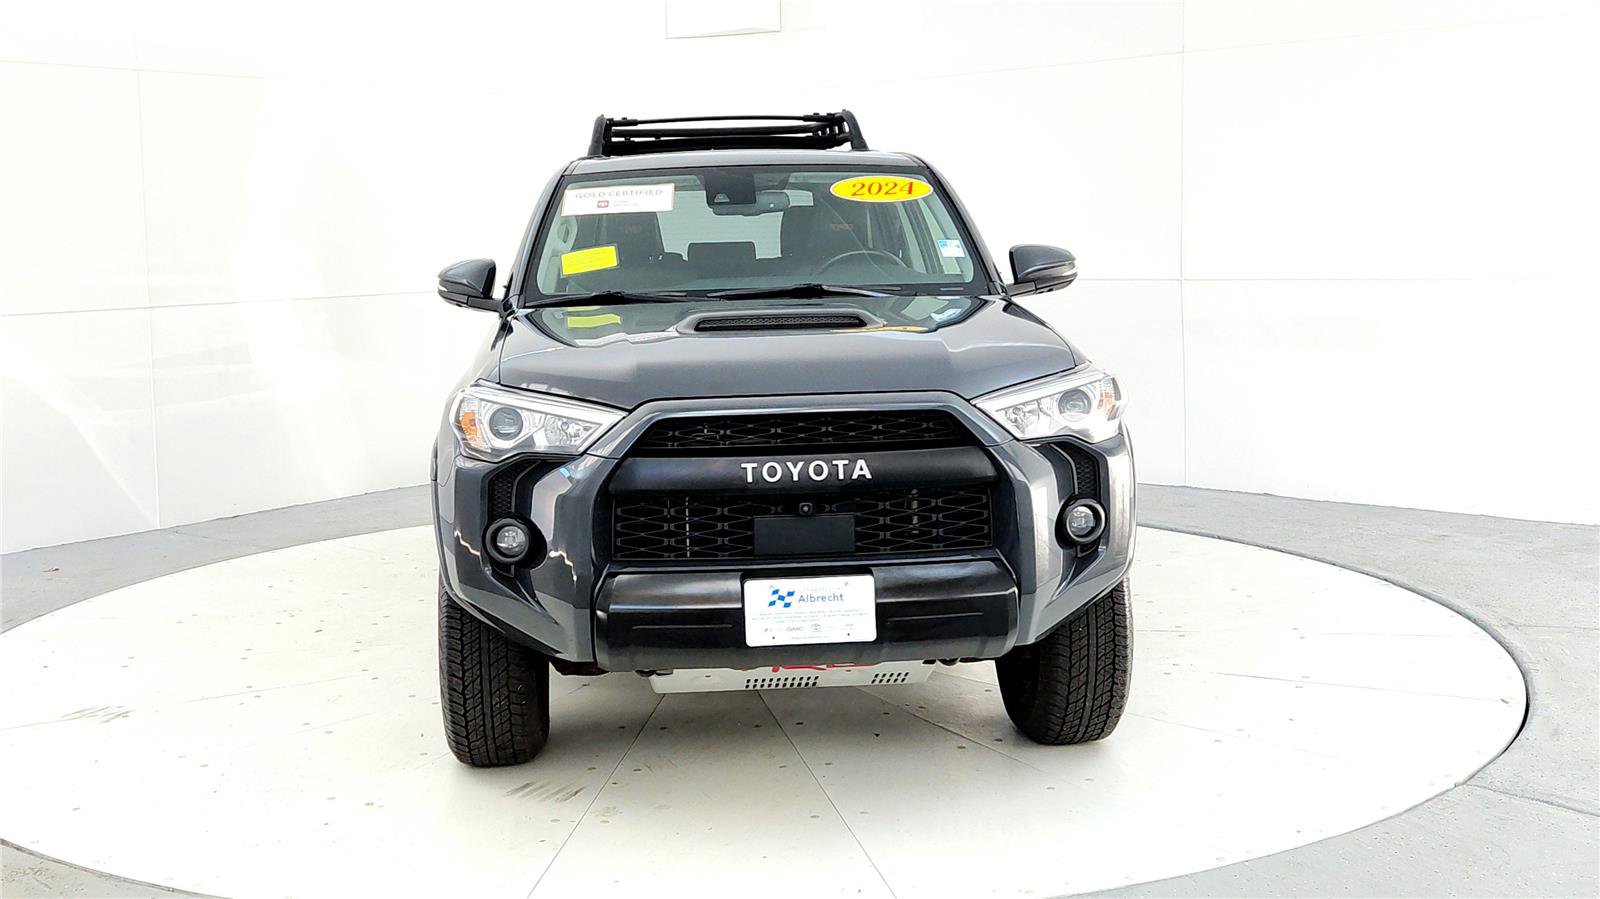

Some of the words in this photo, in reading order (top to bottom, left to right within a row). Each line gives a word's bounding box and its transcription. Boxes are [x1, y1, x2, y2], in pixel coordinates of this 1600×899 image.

[575, 191, 606, 199] GOLD
[608, 189, 664, 198] CERTIFIED
[850, 181, 915, 197] 2024
[740, 458, 873, 483] TOYOTA
[798, 592, 845, 603] Albrecht
